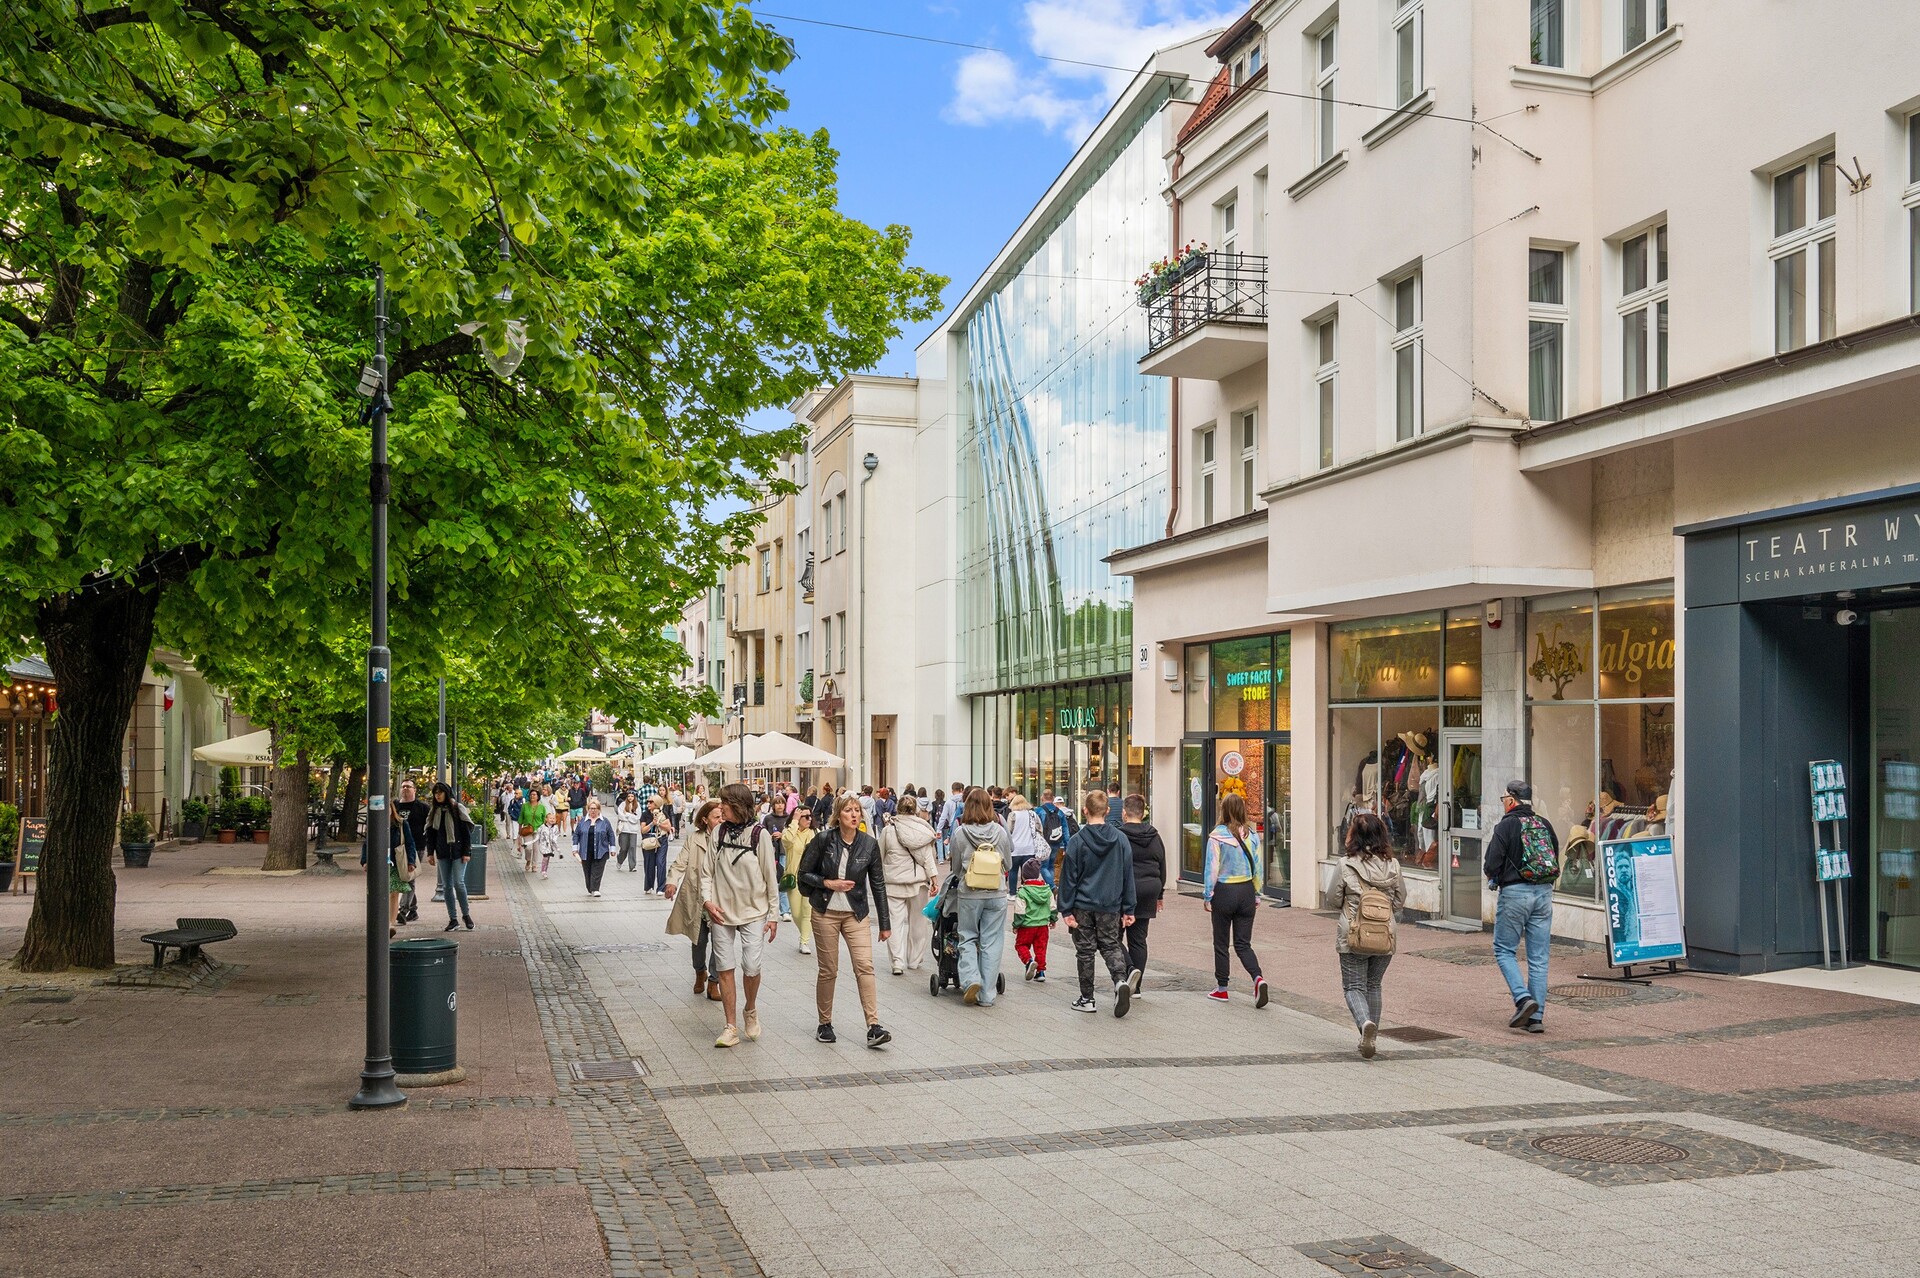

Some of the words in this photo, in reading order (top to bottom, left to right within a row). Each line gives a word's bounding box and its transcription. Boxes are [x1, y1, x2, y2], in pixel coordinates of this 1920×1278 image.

[1746, 524, 1858, 561] TEATR
[1745, 569, 1790, 583] SCENA
[1798, 555, 1892, 576] KAMERALNA
[1140, 647, 1148, 661] 30
[1226, 671, 1249, 687] SWEET
[1250, 668, 1283, 685] FACTOY
[1243, 686, 1267, 701] STORE
[1060, 706, 1096, 728] DOUGLAS
[1605, 846, 1618, 888] 2025
[1610, 893, 1621, 929] MAJ
